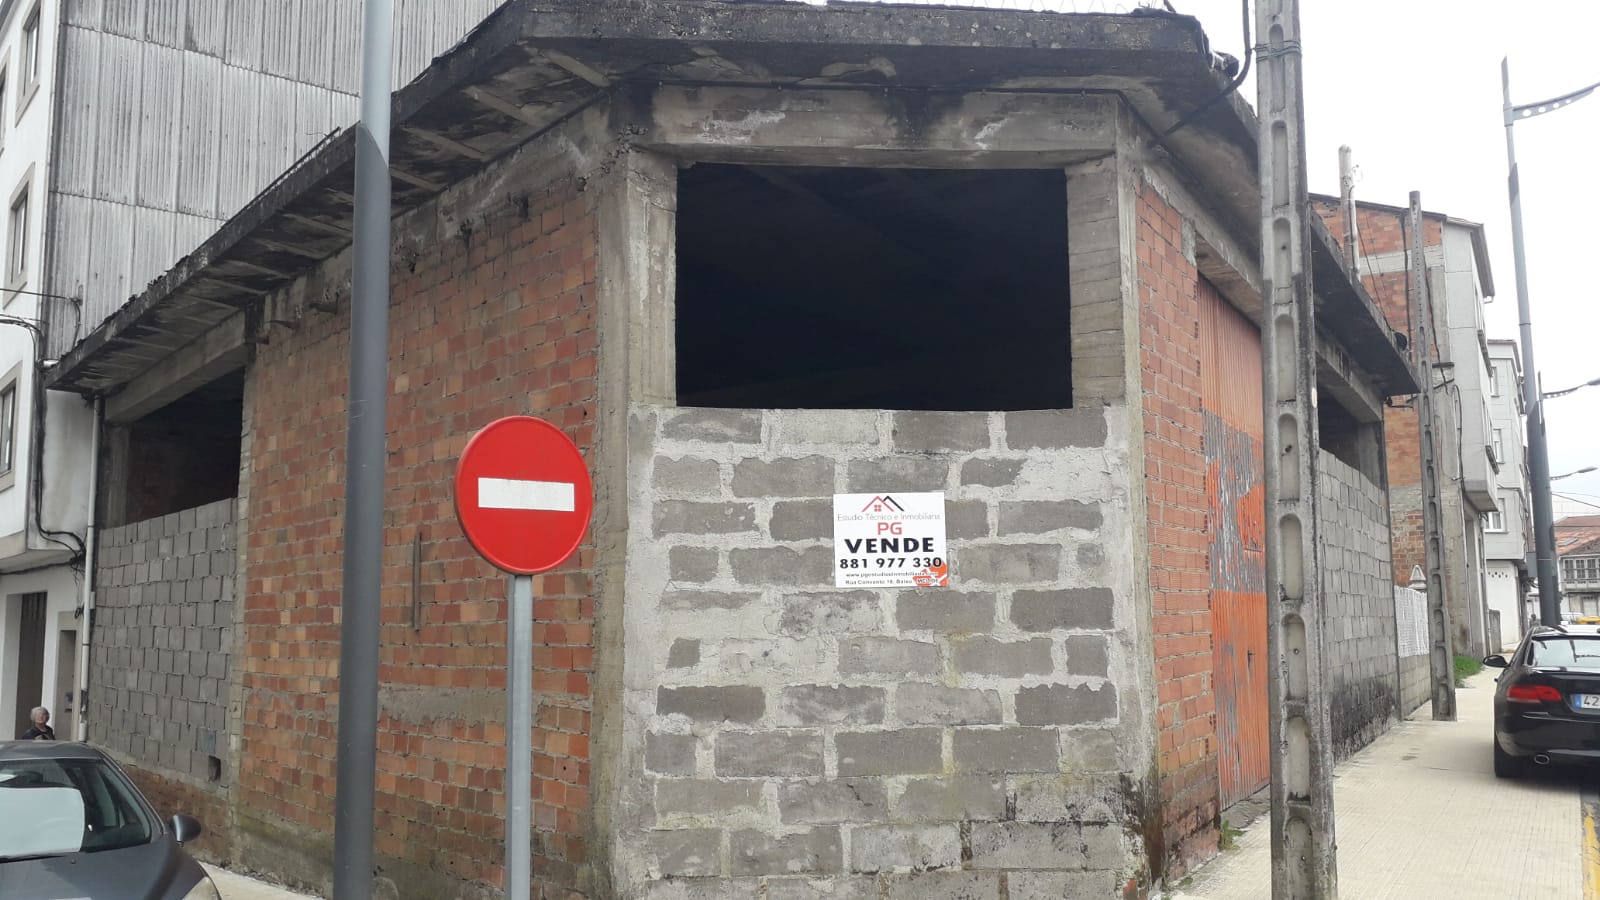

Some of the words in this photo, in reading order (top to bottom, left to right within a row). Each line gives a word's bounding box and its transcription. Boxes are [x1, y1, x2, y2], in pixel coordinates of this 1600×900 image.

[877, 522, 903, 535] PG
[844, 537, 934, 554] VENDE
[840, 558, 868, 569] 881
[876, 557, 906, 568] 977
[912, 557, 942, 568] 330
